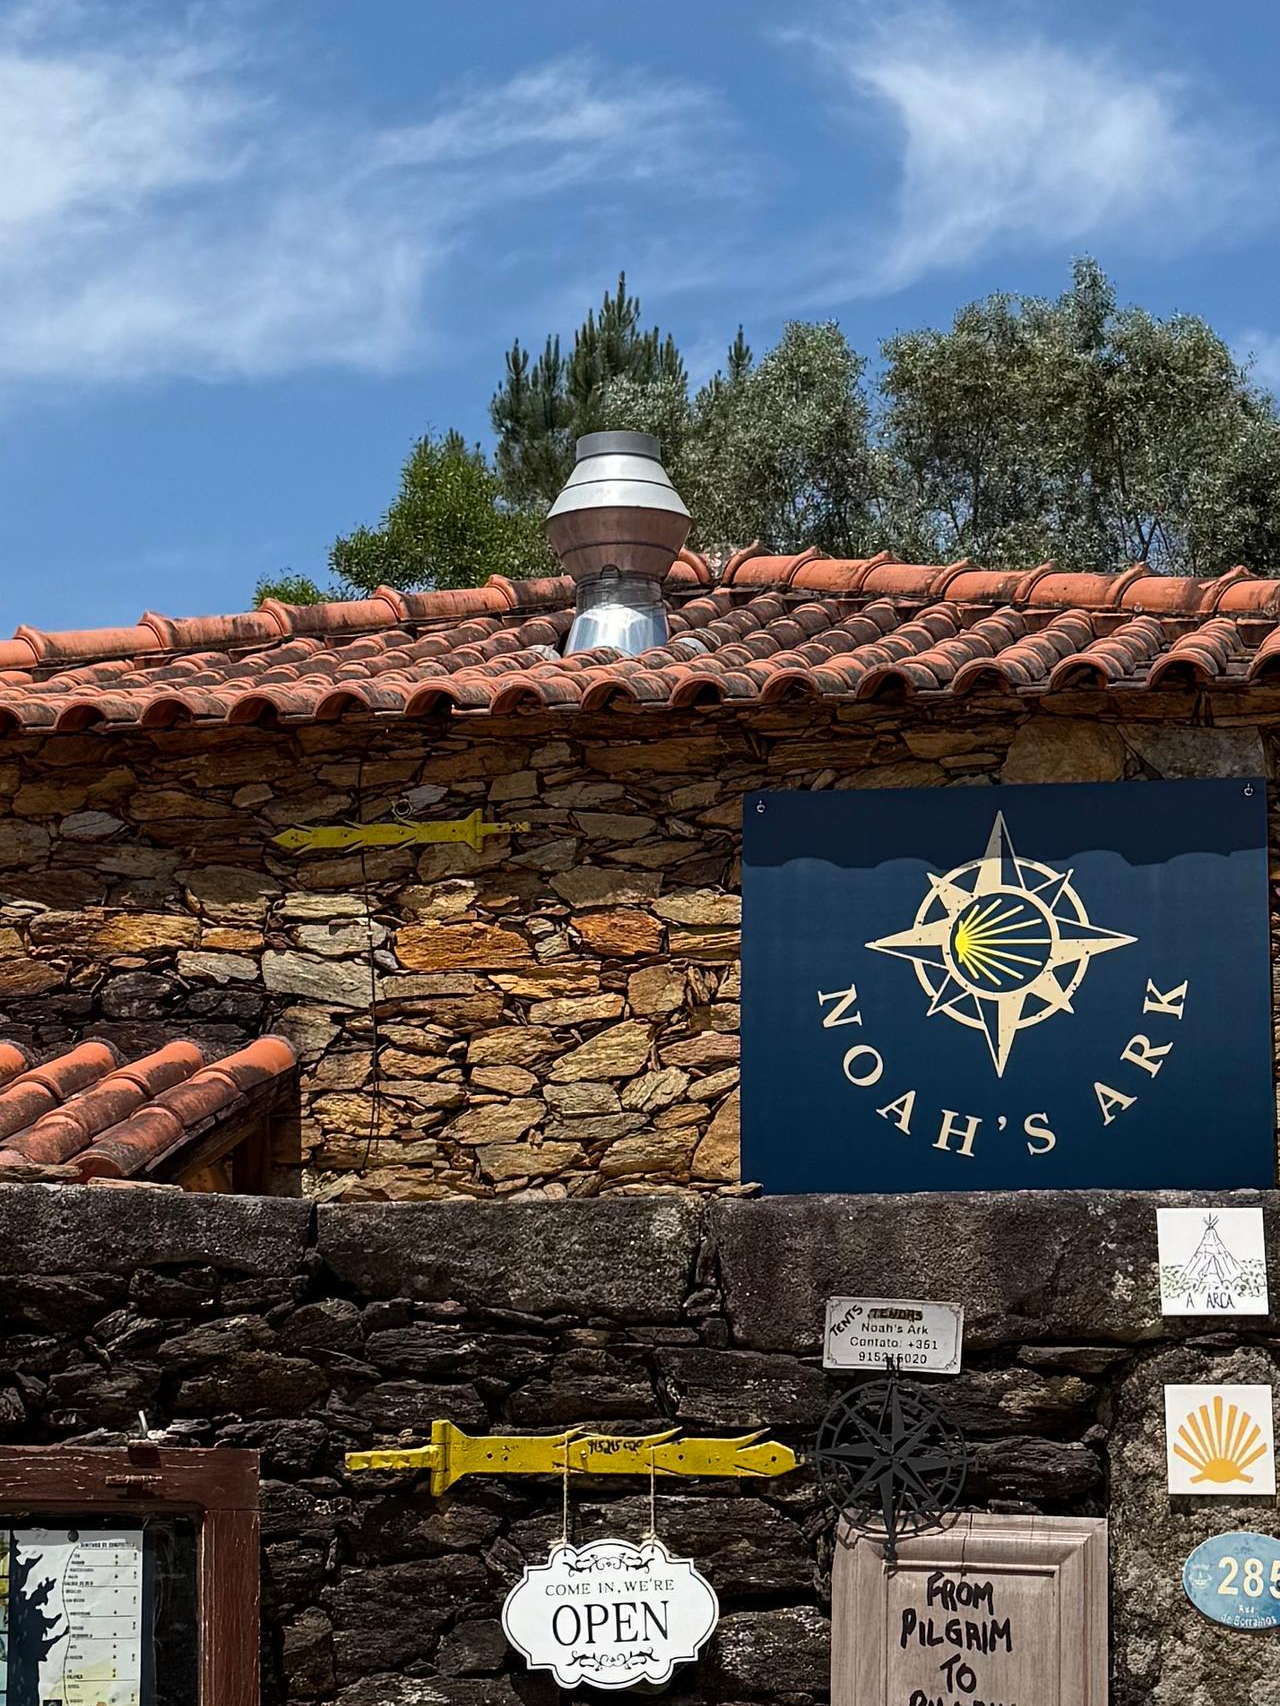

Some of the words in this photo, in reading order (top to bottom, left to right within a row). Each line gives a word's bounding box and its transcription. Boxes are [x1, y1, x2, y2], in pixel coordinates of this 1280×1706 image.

[817, 983, 1057, 1157] NOAH'S
[1093, 977, 1189, 1126] ARK
[1186, 1292, 1195, 1308] A
[1207, 1292, 1236, 1308] ARCA
[830, 1304, 864, 1337] TENTS
[862, 1323, 903, 1333] Noah's
[907, 1324, 928, 1334] Ark
[850, 1337, 902, 1348] Contato:
[545, 1583, 591, 1596] COME
[624, 1578, 675, 1592] WE'RE
[927, 1571, 994, 1614] FROM
[552, 1601, 669, 1646] OPEN
[900, 1608, 1012, 1654] PILGRIM
[939, 1654, 977, 1693] TO
